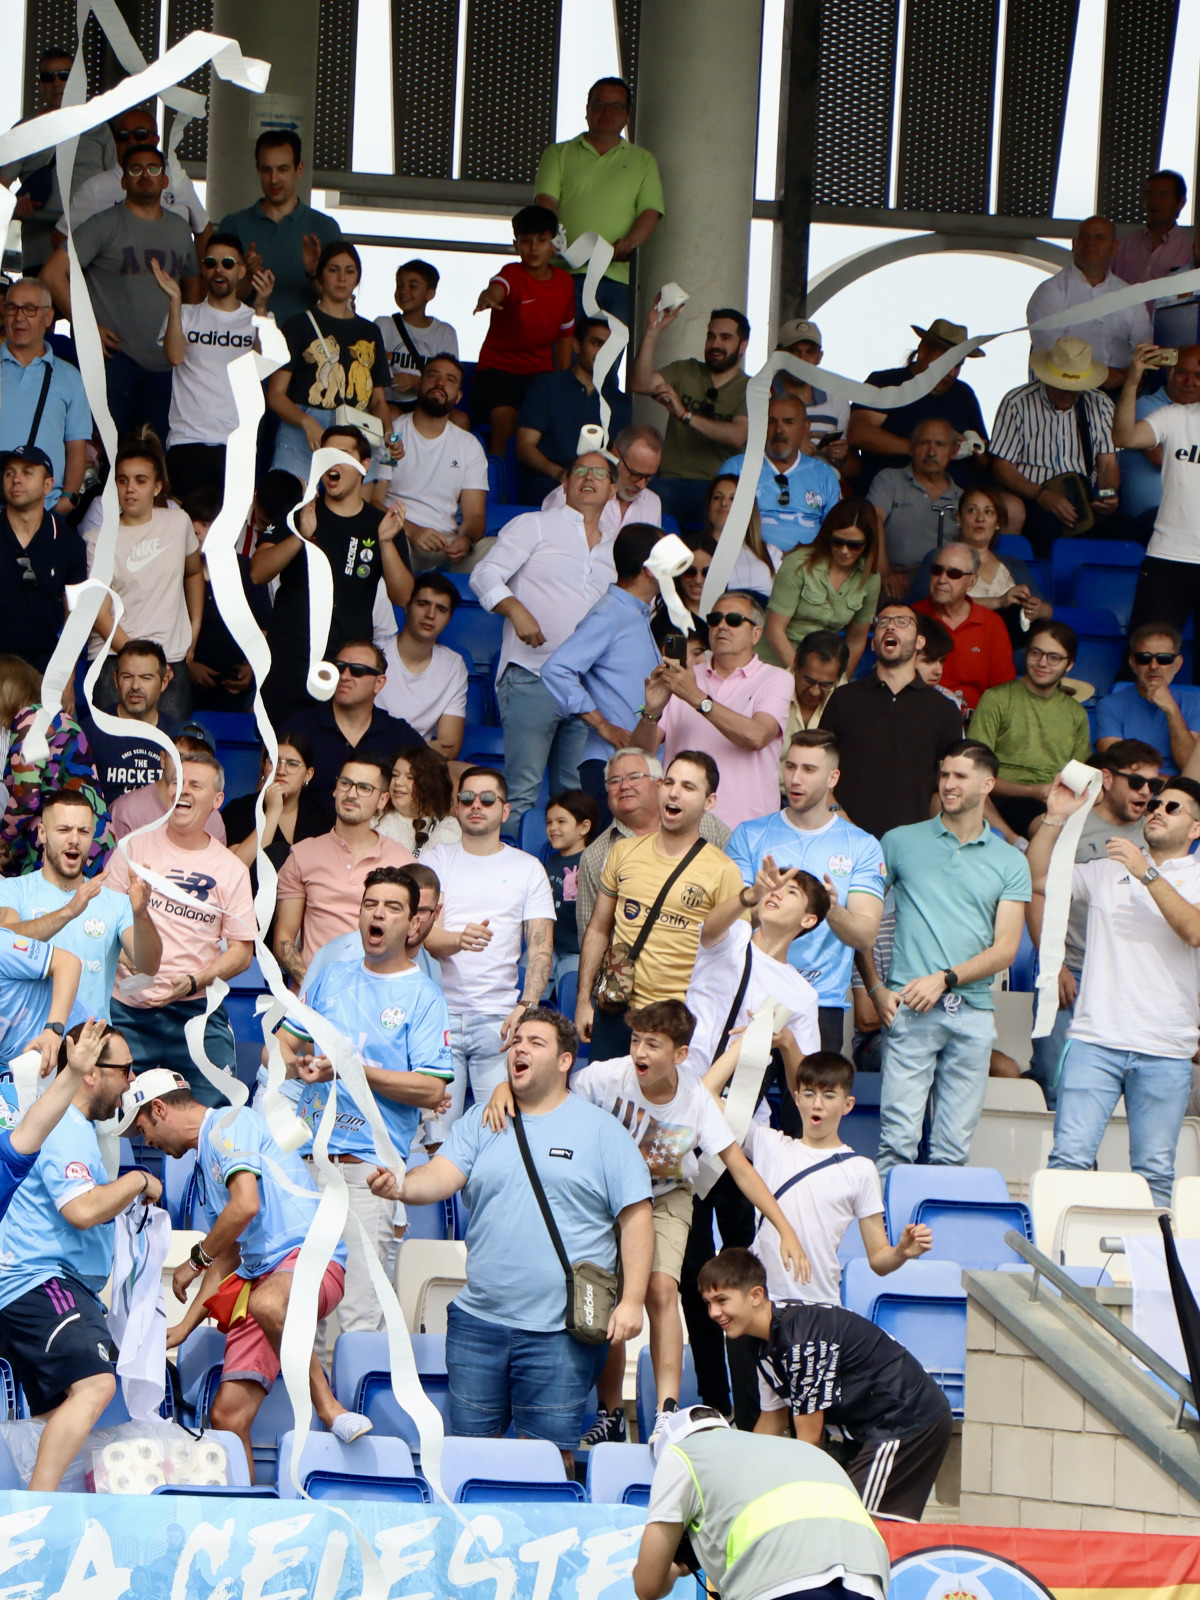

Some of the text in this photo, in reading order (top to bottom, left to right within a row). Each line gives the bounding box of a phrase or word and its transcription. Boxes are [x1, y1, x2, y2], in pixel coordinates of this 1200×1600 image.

[188, 331, 253, 347] adidas
[129, 537, 161, 560] NIKE
[134, 758, 148, 768] THE
[164, 900, 216, 924] balance
[643, 907, 690, 928] Sotify
[586, 1284, 594, 1326] adidas
[792, 1344, 800, 1362] NIK
[819, 1340, 828, 1359] NIK
[824, 1381, 834, 1401] NIKE
[169, 1513, 645, 1600] CELESTE
